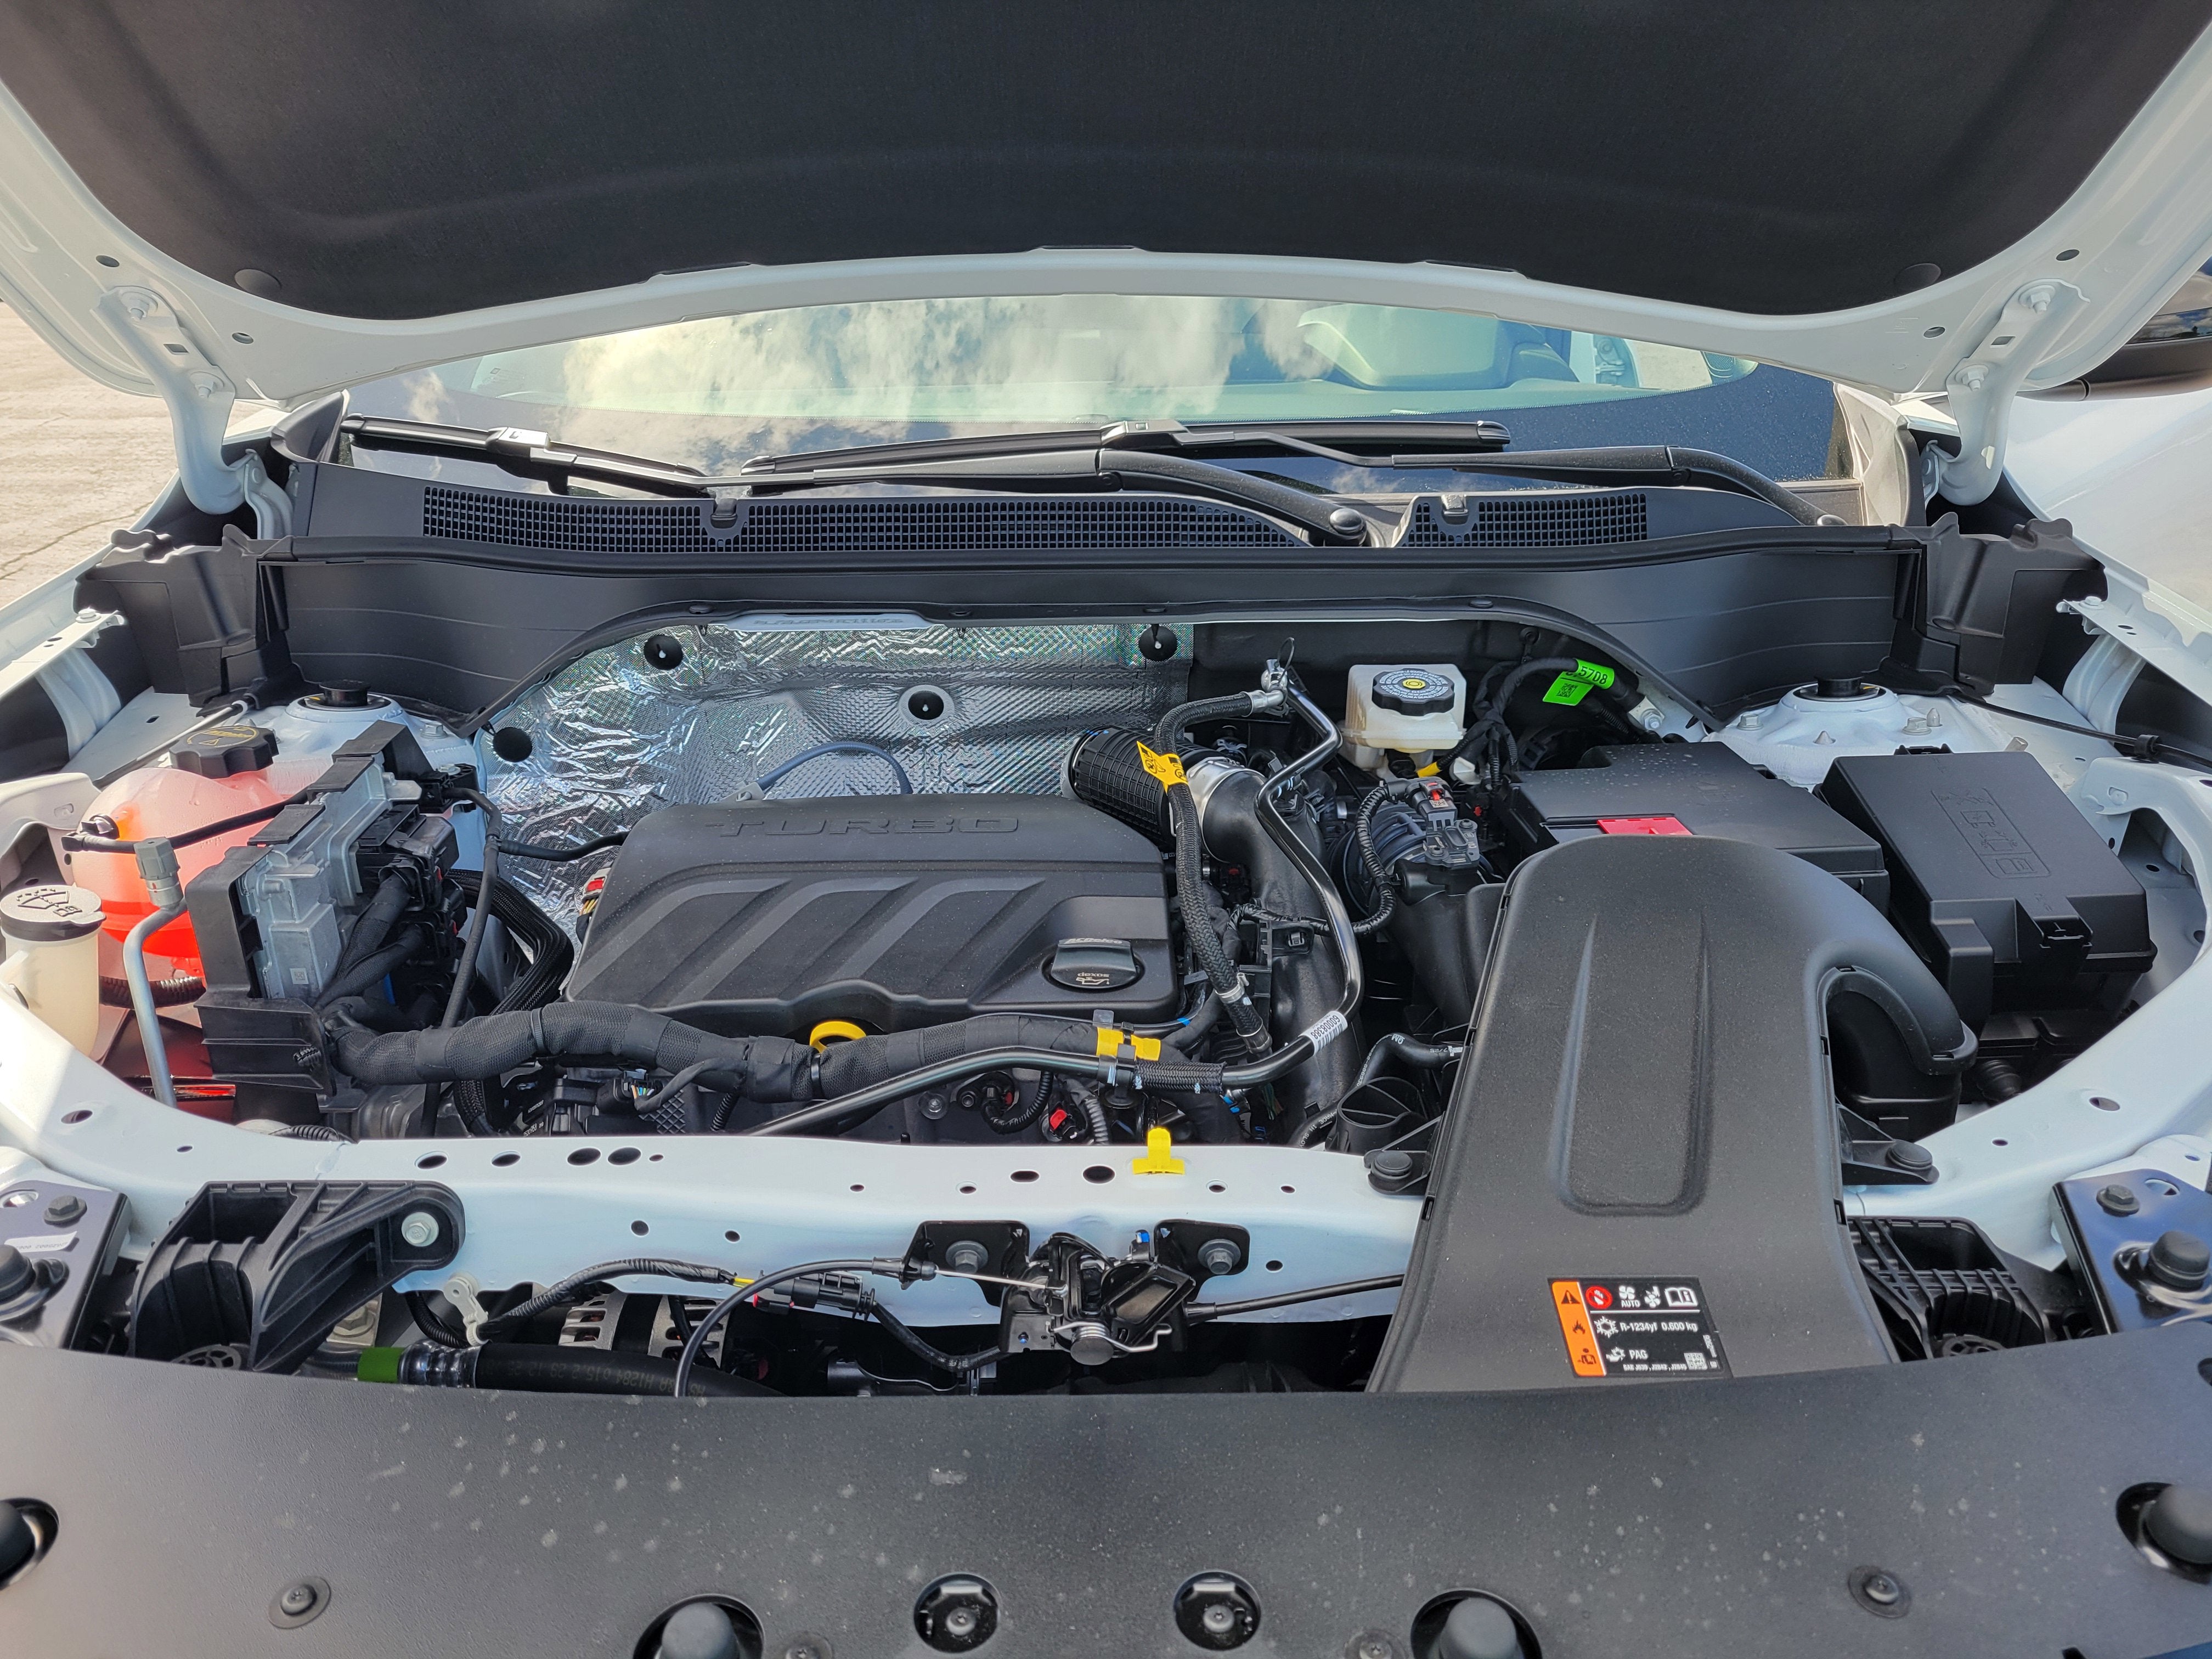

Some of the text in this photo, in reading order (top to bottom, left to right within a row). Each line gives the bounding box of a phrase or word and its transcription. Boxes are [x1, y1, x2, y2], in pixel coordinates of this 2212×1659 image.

[706, 818, 1019, 837] TURBO
[1310, 1015, 1340, 1040] 60008388
[1309, 1124, 1317, 1132] IN
[1621, 1300, 1640, 1308] AUTO
[1620, 1322, 1699, 1333] R-1234yf 0.600 kg
[1628, 1349, 1649, 1359] PAG
